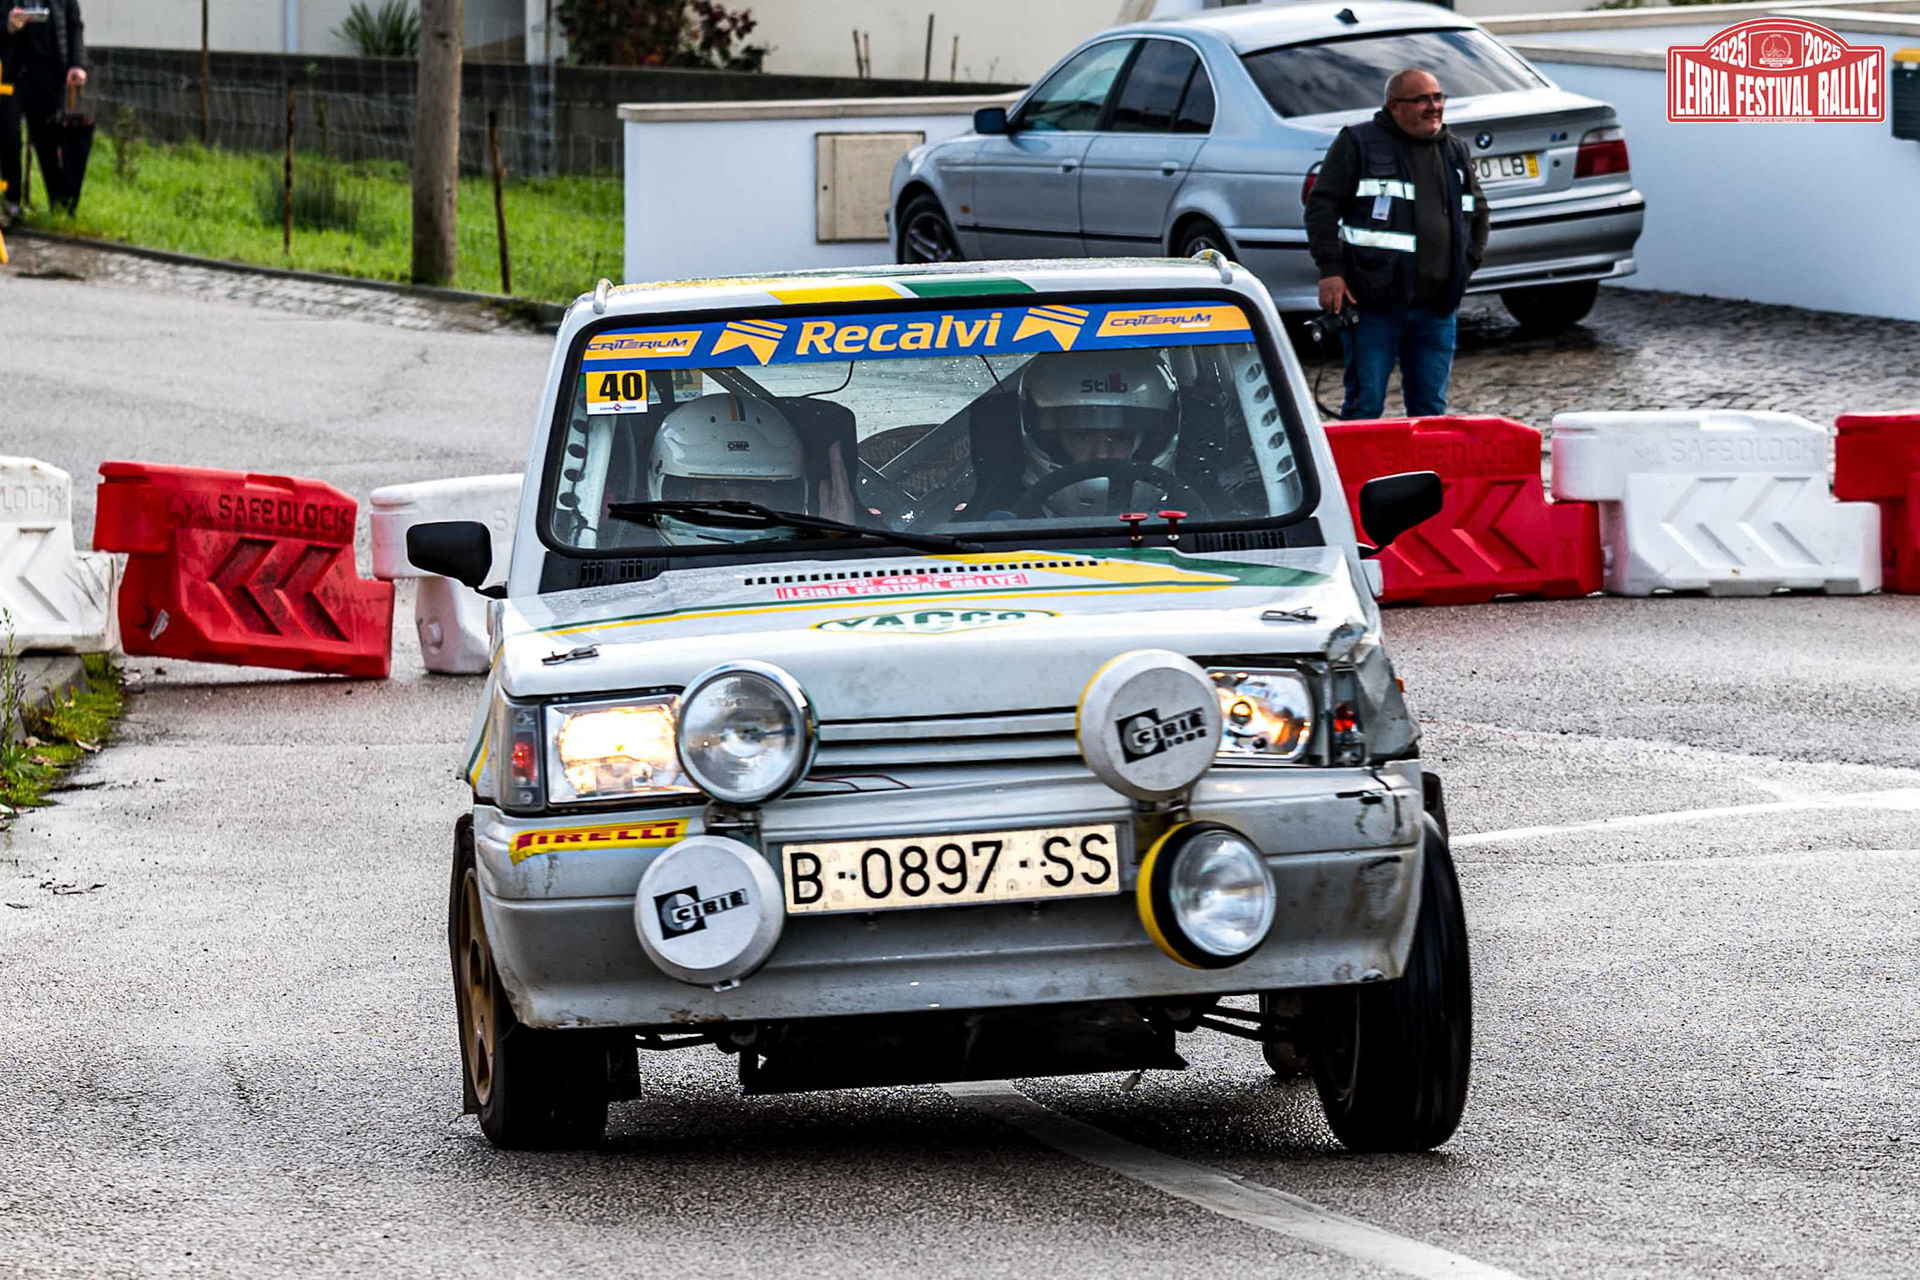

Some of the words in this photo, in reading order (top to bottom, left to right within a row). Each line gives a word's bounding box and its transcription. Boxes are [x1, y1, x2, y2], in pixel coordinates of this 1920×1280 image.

[586, 338, 688, 352] CRITERIUM
[795, 312, 1004, 355] Recalvi
[1110, 313, 1212, 327] CRITERIUM
[599, 372, 643, 401] 40
[516, 821, 679, 850] PIRELLI
